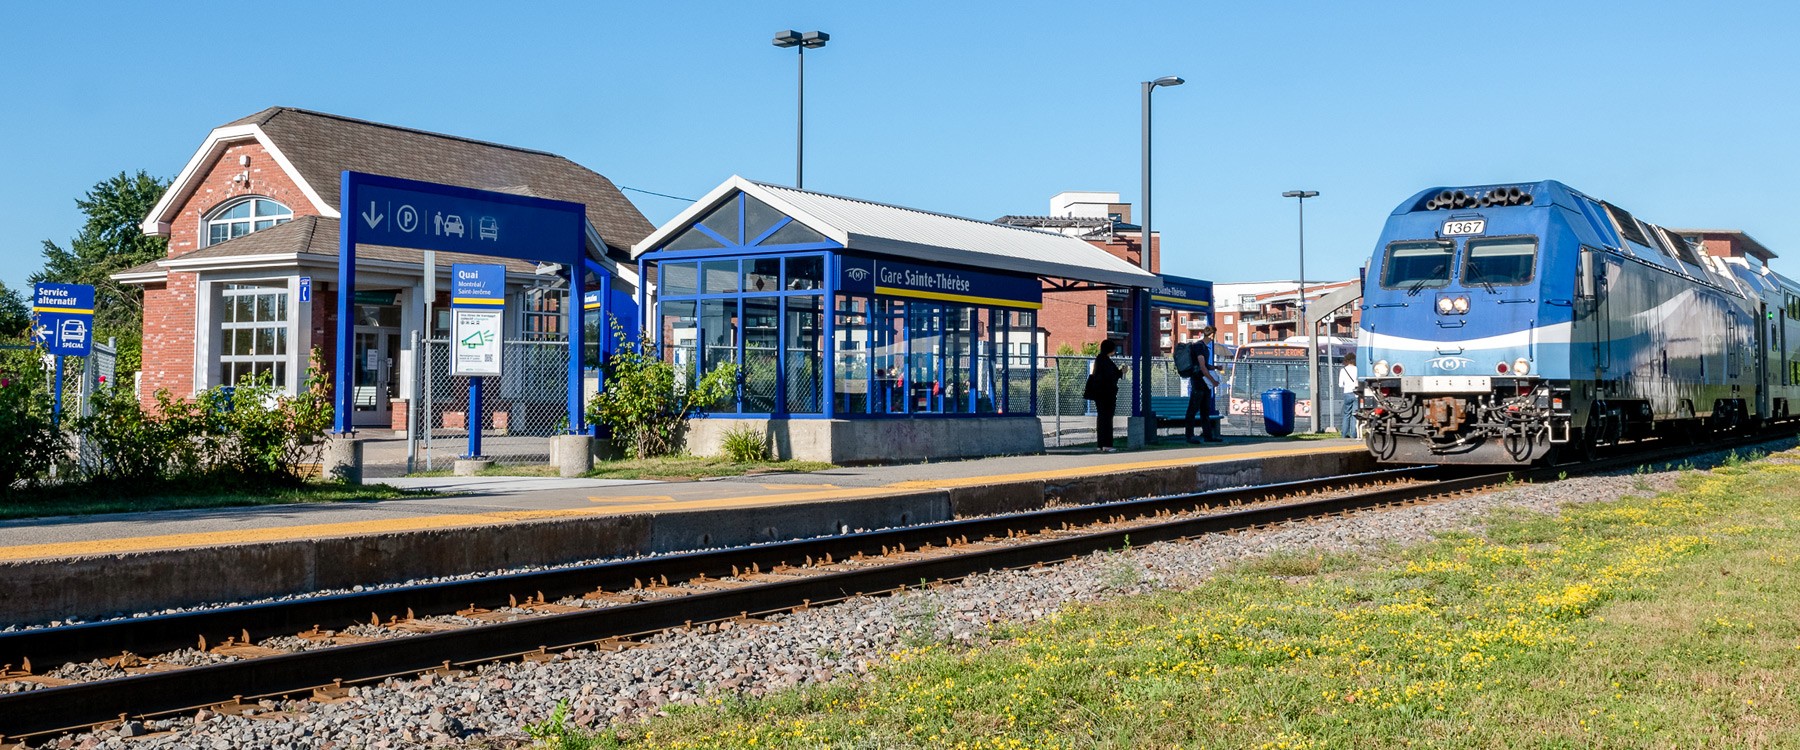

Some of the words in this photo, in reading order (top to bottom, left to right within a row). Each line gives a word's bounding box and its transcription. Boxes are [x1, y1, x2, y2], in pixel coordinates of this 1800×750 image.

[1446, 221, 1482, 234] 1367
[458, 270, 479, 280] Quai
[880, 266, 902, 285] Gare
[905, 269, 970, 292] Sainte-Thérèse
[38, 287, 69, 296] Service
[38, 296, 77, 305] alternatif
[1431, 358, 1469, 370] AMT
